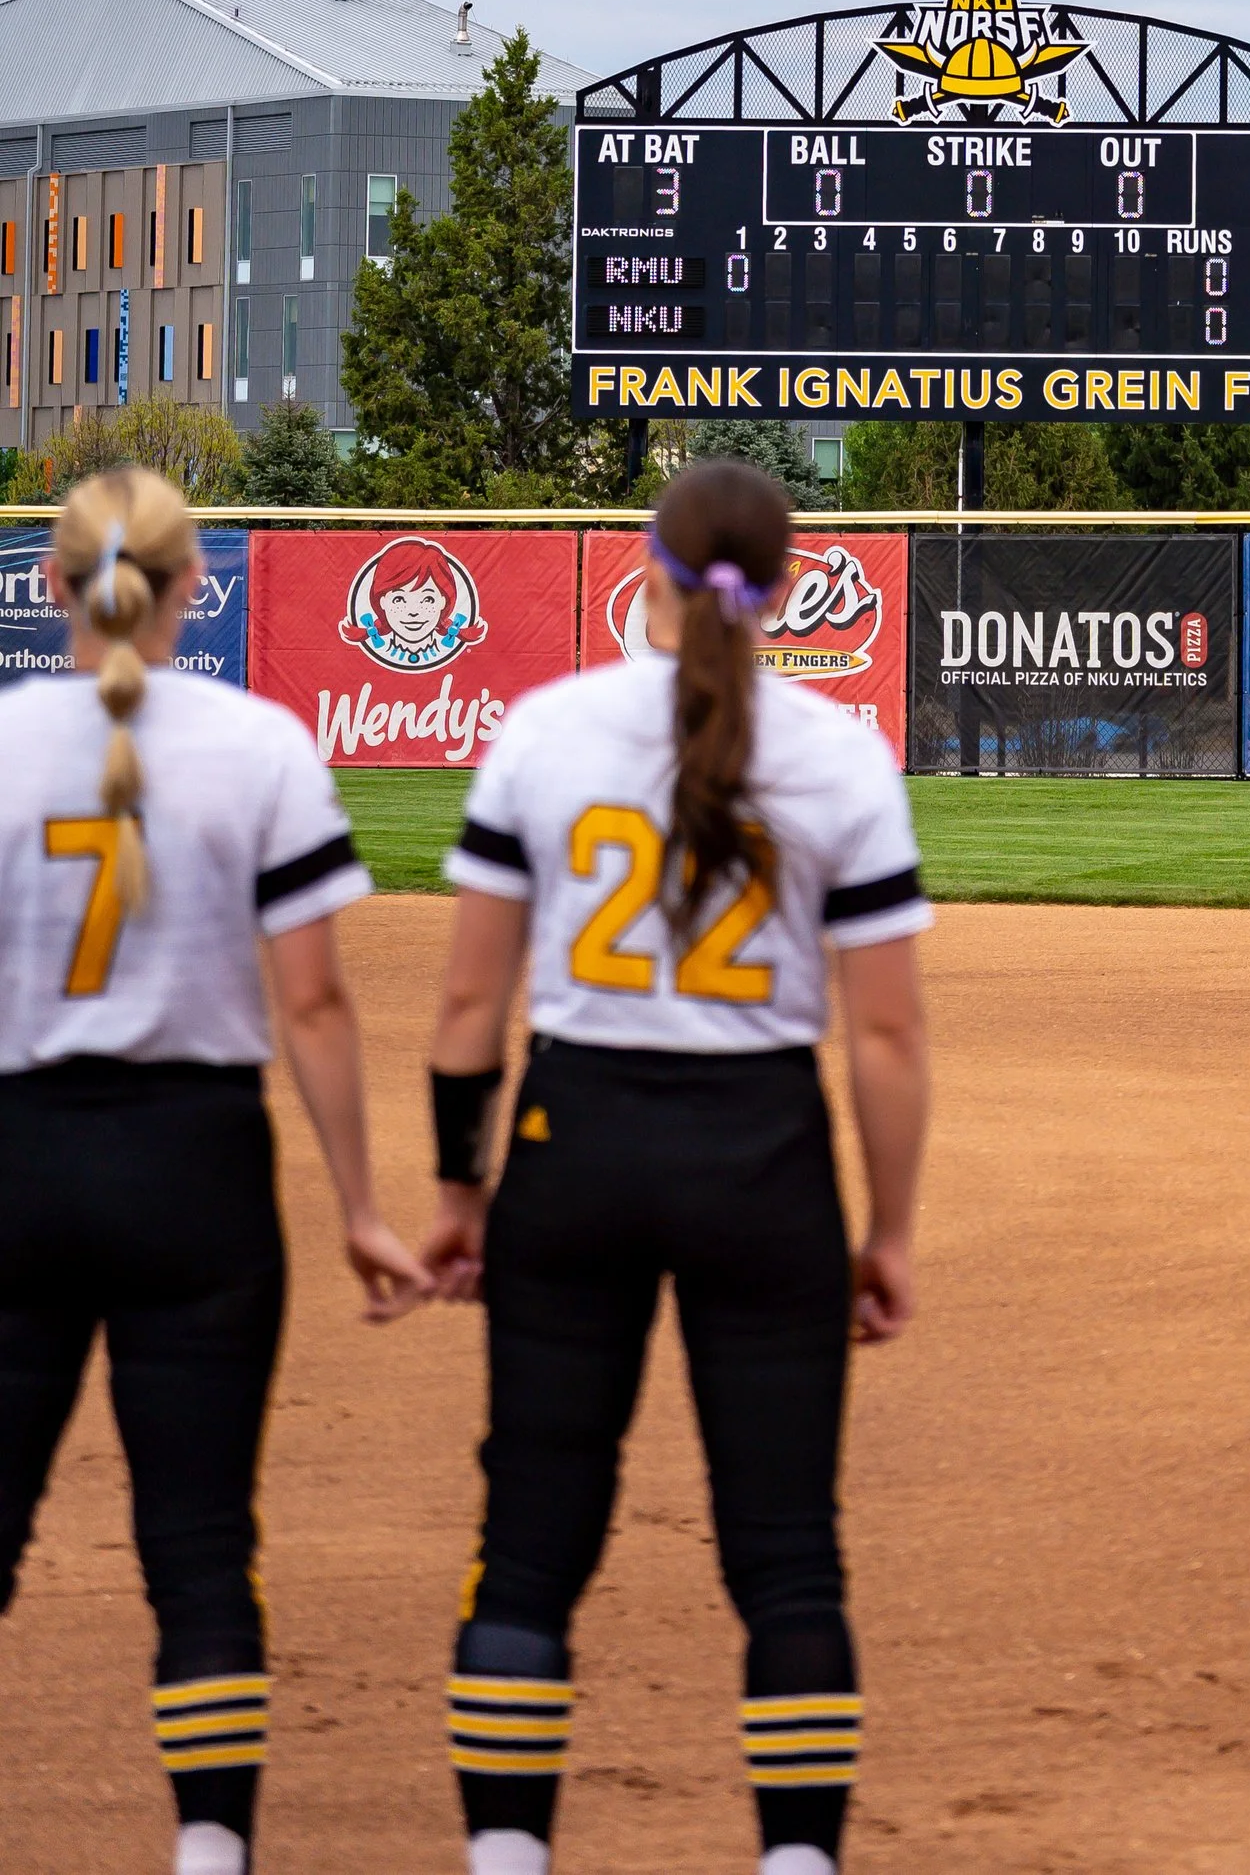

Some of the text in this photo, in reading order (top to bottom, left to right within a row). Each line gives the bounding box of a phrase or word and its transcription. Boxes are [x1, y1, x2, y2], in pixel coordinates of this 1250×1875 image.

[917, 10, 1045, 51] NORSE
[598, 134, 699, 164] AT BAT
[791, 136, 865, 165] BALL
[927, 136, 1031, 166] STRIKE
[1101, 137, 1161, 167] OUT
[656, 168, 680, 215] 3
[816, 169, 842, 216] 0
[967, 170, 992, 217] 0
[1118, 171, 1144, 218] 0
[581, 228, 673, 237] DAKTRONICS
[736, 226, 746, 250] 1
[773, 227, 786, 251] 2
[813, 228, 827, 251] 3
[863, 228, 876, 251] 4
[903, 228, 916, 252] 5
[943, 228, 956, 252] 6
[993, 228, 1006, 252] 7
[1032, 228, 1045, 252] 8
[1072, 229, 1084, 253] 9
[1113, 229, 1140, 253] 10
[1167, 230, 1232, 254] RUNS
[606, 257, 683, 284] RMU
[727, 255, 748, 292] 0
[1206, 258, 1227, 297] 0
[609, 305, 682, 333] NKU
[1205, 307, 1227, 346] 0
[588, 366, 763, 407] FRANK
[778, 367, 1023, 410] IGNATIUS
[1042, 369, 1200, 411] GREIN
[940, 611, 1175, 669] DONATOS
[1187, 618, 1201, 663] PIZZA
[941, 671, 1208, 686] OFFICIAL PIZZA OF NKU ATHLETICS
[318, 674, 504, 761] Wendy's
[44, 817, 143, 998] 7
